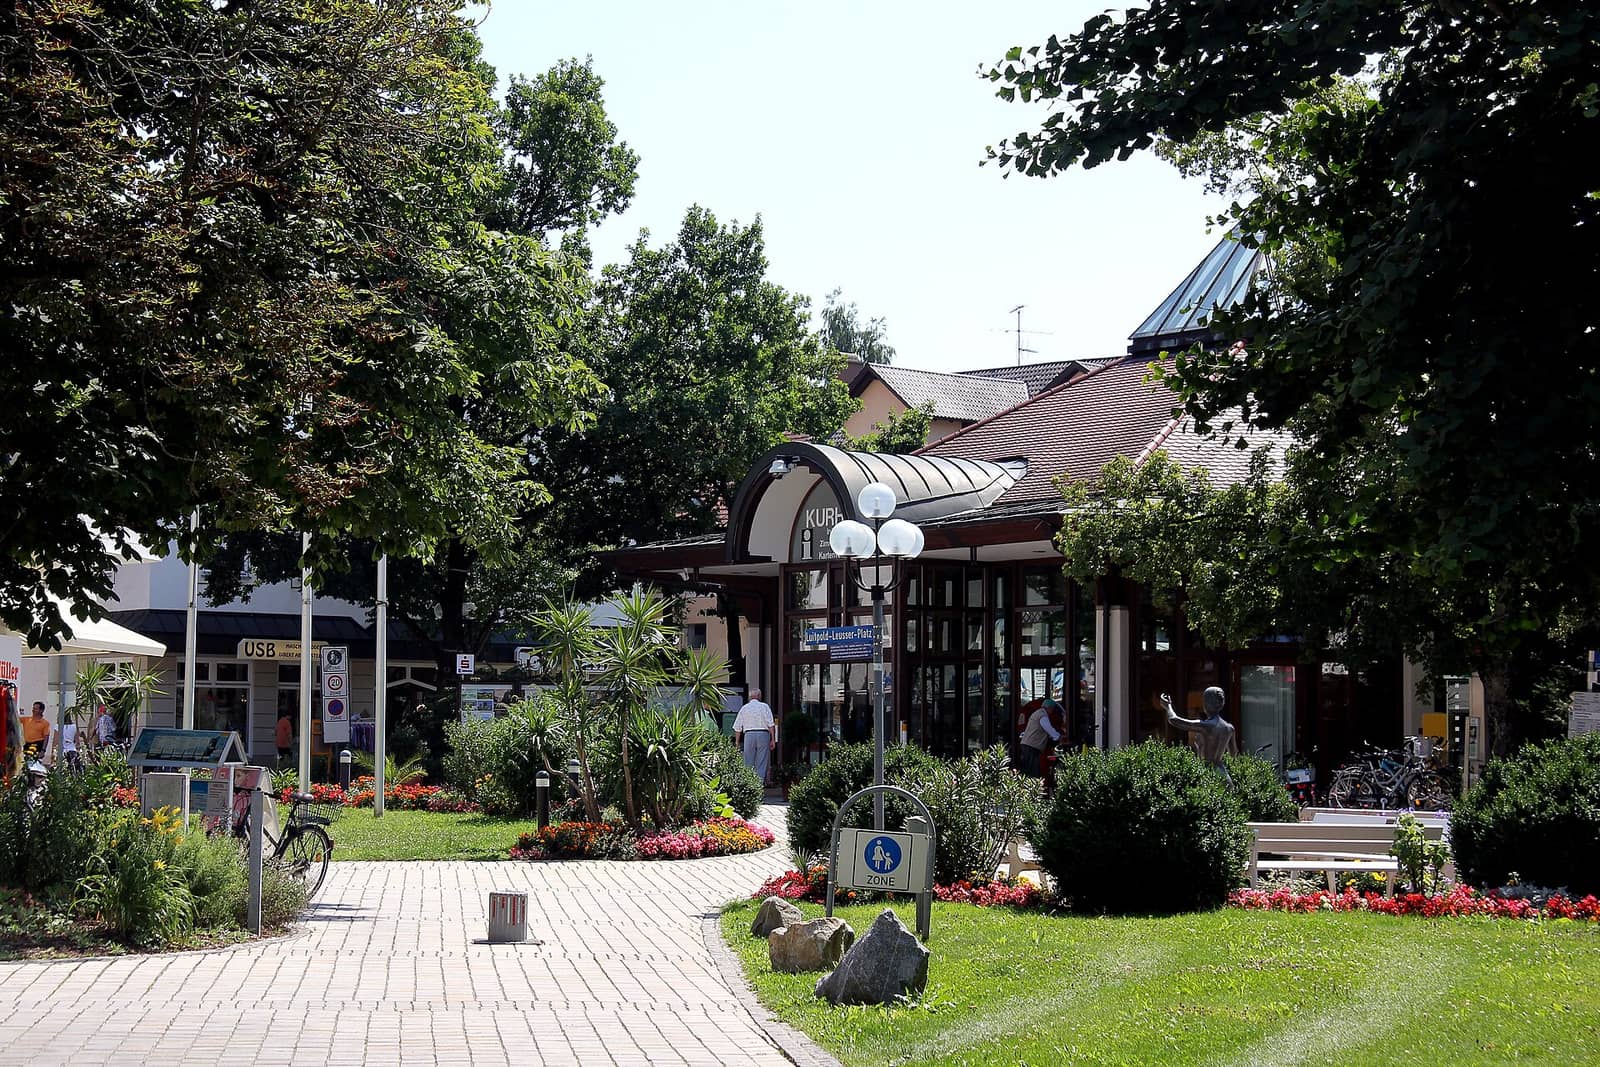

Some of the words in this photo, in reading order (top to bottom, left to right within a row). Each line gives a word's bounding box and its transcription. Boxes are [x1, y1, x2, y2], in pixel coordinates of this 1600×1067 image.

[806, 628, 873, 643] Luitpold-Leusser-Platz
[244, 641, 276, 658] USB
[0, 660, 19, 681] üller
[331, 678, 341, 687] 20
[866, 875, 896, 887] ZONE
